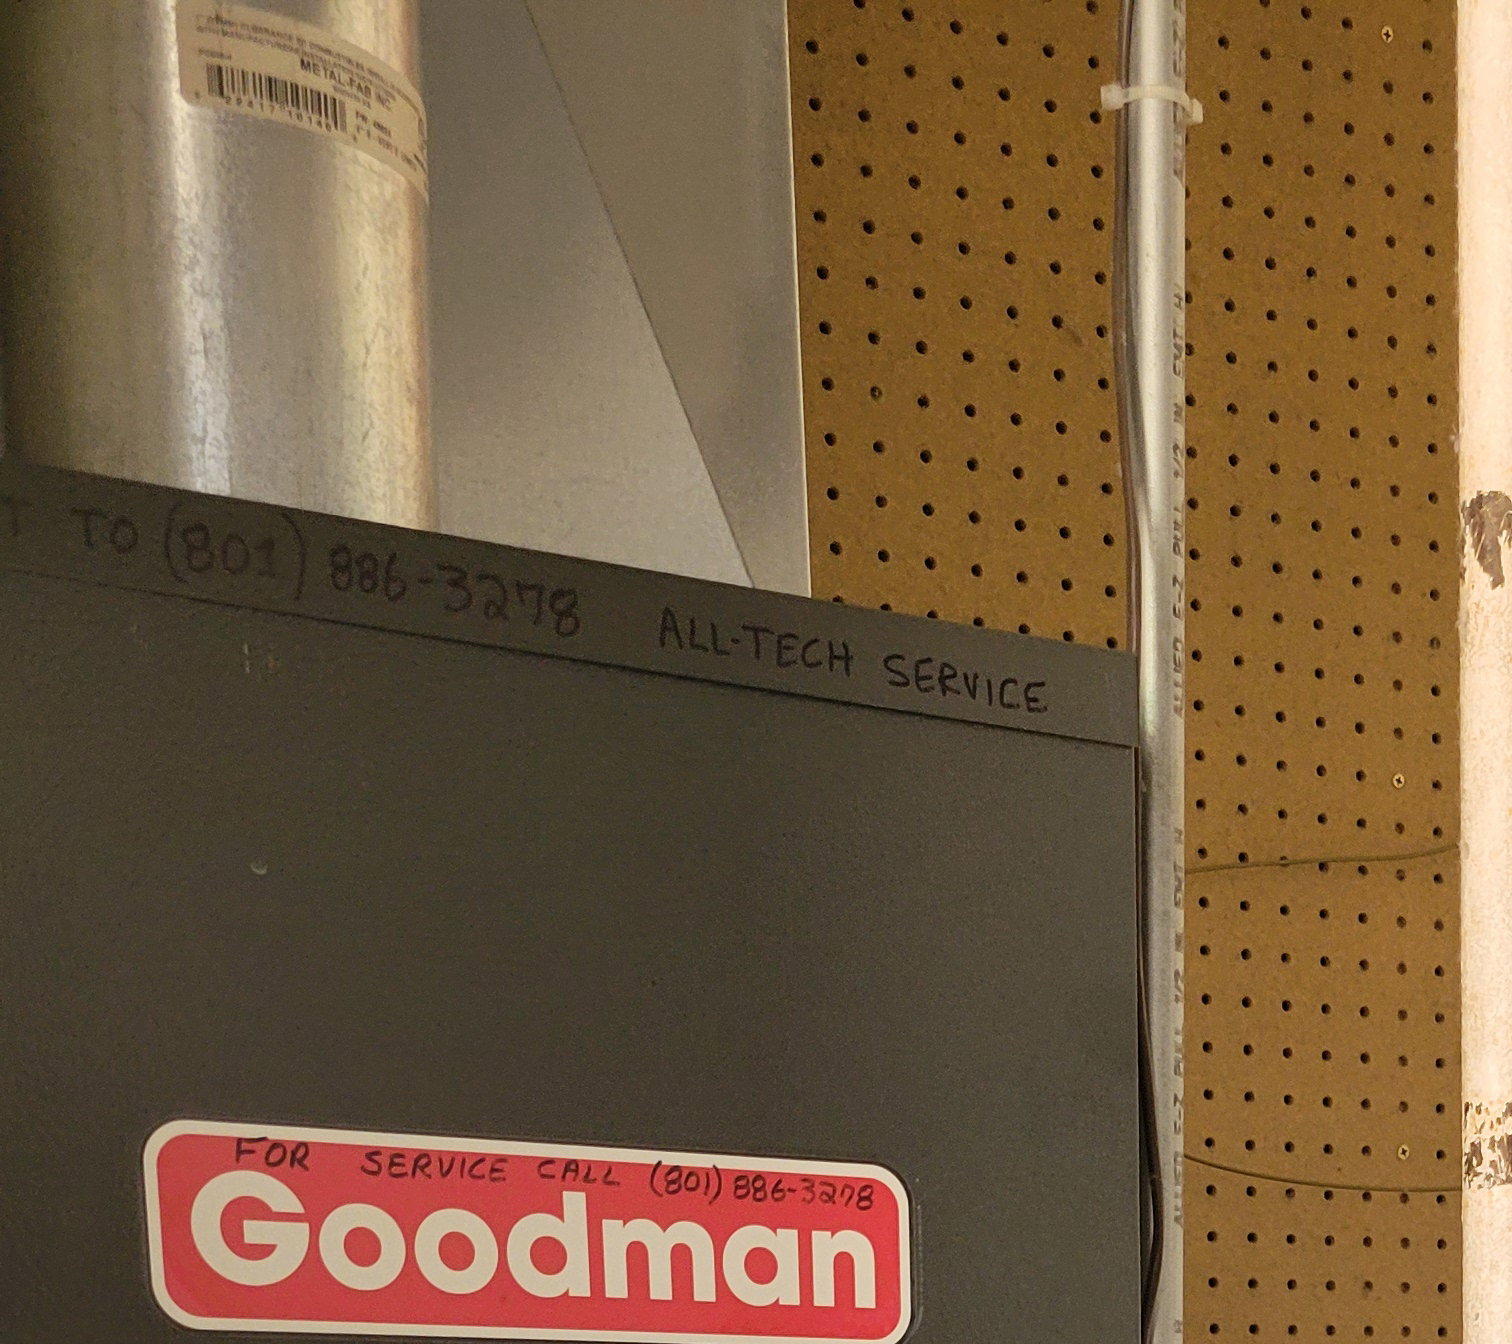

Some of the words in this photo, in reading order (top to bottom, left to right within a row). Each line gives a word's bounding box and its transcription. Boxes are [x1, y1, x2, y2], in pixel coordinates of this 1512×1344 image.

[71, 505, 139, 554] TO
[164, 502, 306, 602] (801)
[330, 545, 580, 638] 886-3278
[883, 652, 1049, 714] SERVICE
[190, 1169, 876, 1309] Goodman
[235, 1136, 309, 1172] FOR
[360, 1151, 508, 1183] SERVICE
[537, 1159, 620, 1187] CALL
[650, 1160, 723, 1205] (801)
[732, 1174, 874, 1211] 886-3278
